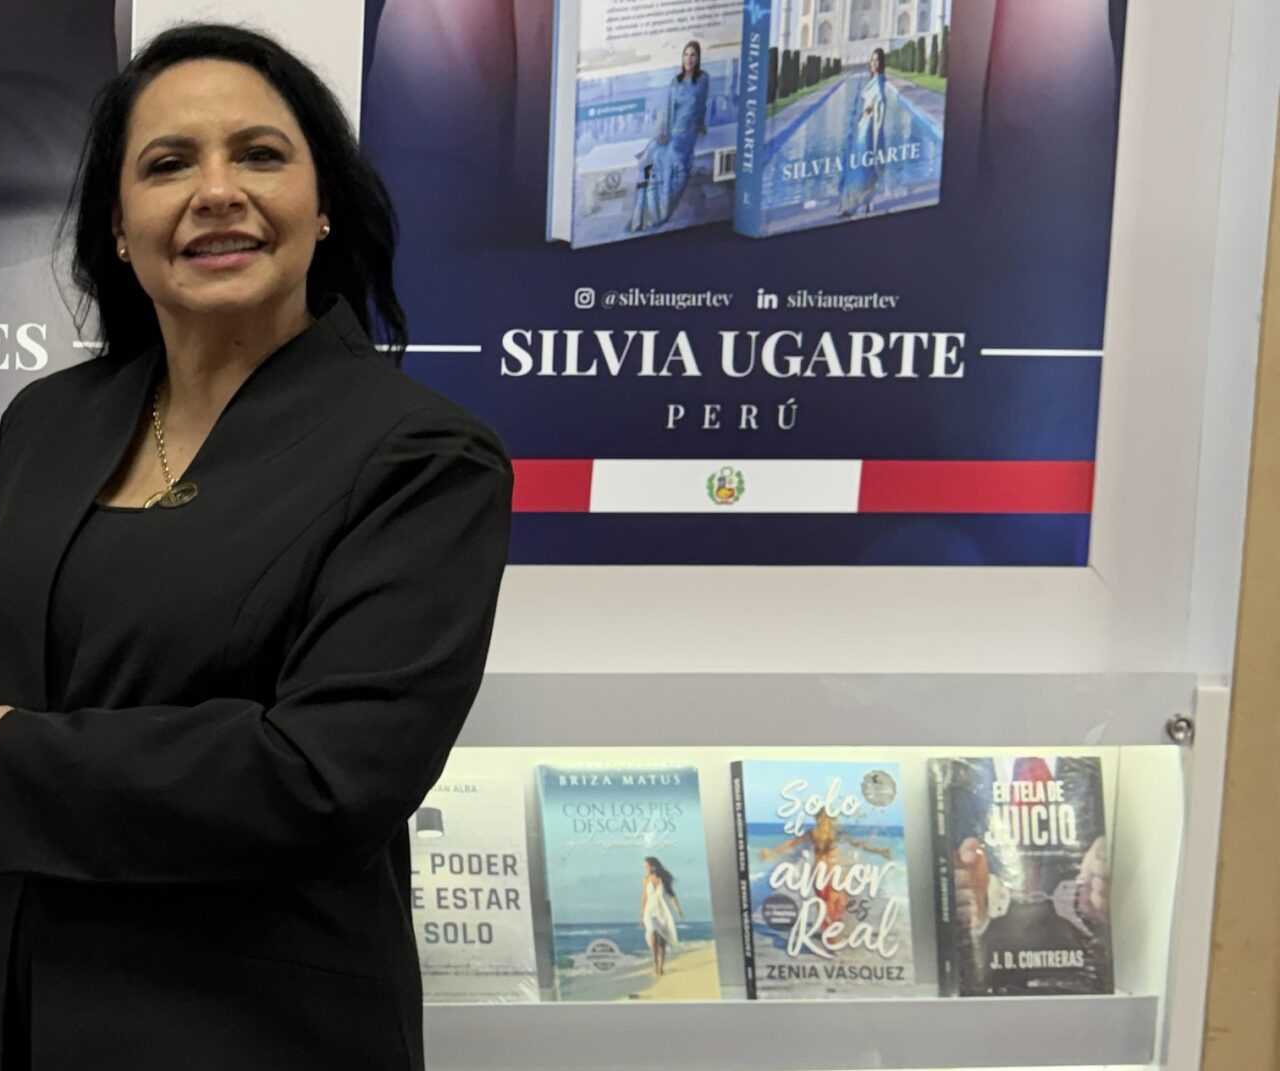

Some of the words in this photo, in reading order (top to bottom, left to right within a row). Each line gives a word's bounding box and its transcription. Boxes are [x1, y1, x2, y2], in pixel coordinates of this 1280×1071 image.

[746, 31, 760, 92] SILVIA
[742, 99, 757, 174] UGARTE
[783, 156, 843, 180] SILVIA
[849, 142, 921, 170] UGARTE
[500, 327, 702, 378] SILVIA
[718, 330, 966, 379] UGARTE
[665, 397, 799, 430] PERÚ
[453, 785, 477, 793] ALBA
[559, 775, 612, 786] BRIZA
[622, 774, 681, 785] MATUS
[1011, 780, 1046, 802] TELA
[1046, 780, 1065, 802] DE
[562, 802, 605, 817] CON
[610, 801, 644, 817] LOS
[648, 801, 683, 816] PIES
[777, 778, 861, 819] Solo
[573, 818, 677, 833] DESCALZOS
[784, 815, 805, 837] el
[984, 803, 1077, 847] JUICIO
[430, 853, 518, 876] PODER
[767, 848, 895, 898] amor
[436, 887, 521, 910] ESTAR
[846, 899, 870, 923] es
[424, 922, 493, 944] SOLO
[786, 895, 902, 959] Real
[990, 951, 1003, 969] J.
[1018, 950, 1084, 968] CONTRERAS
[766, 964, 820, 981] ZENIA
[823, 962, 905, 981] VÁSQUEZ
